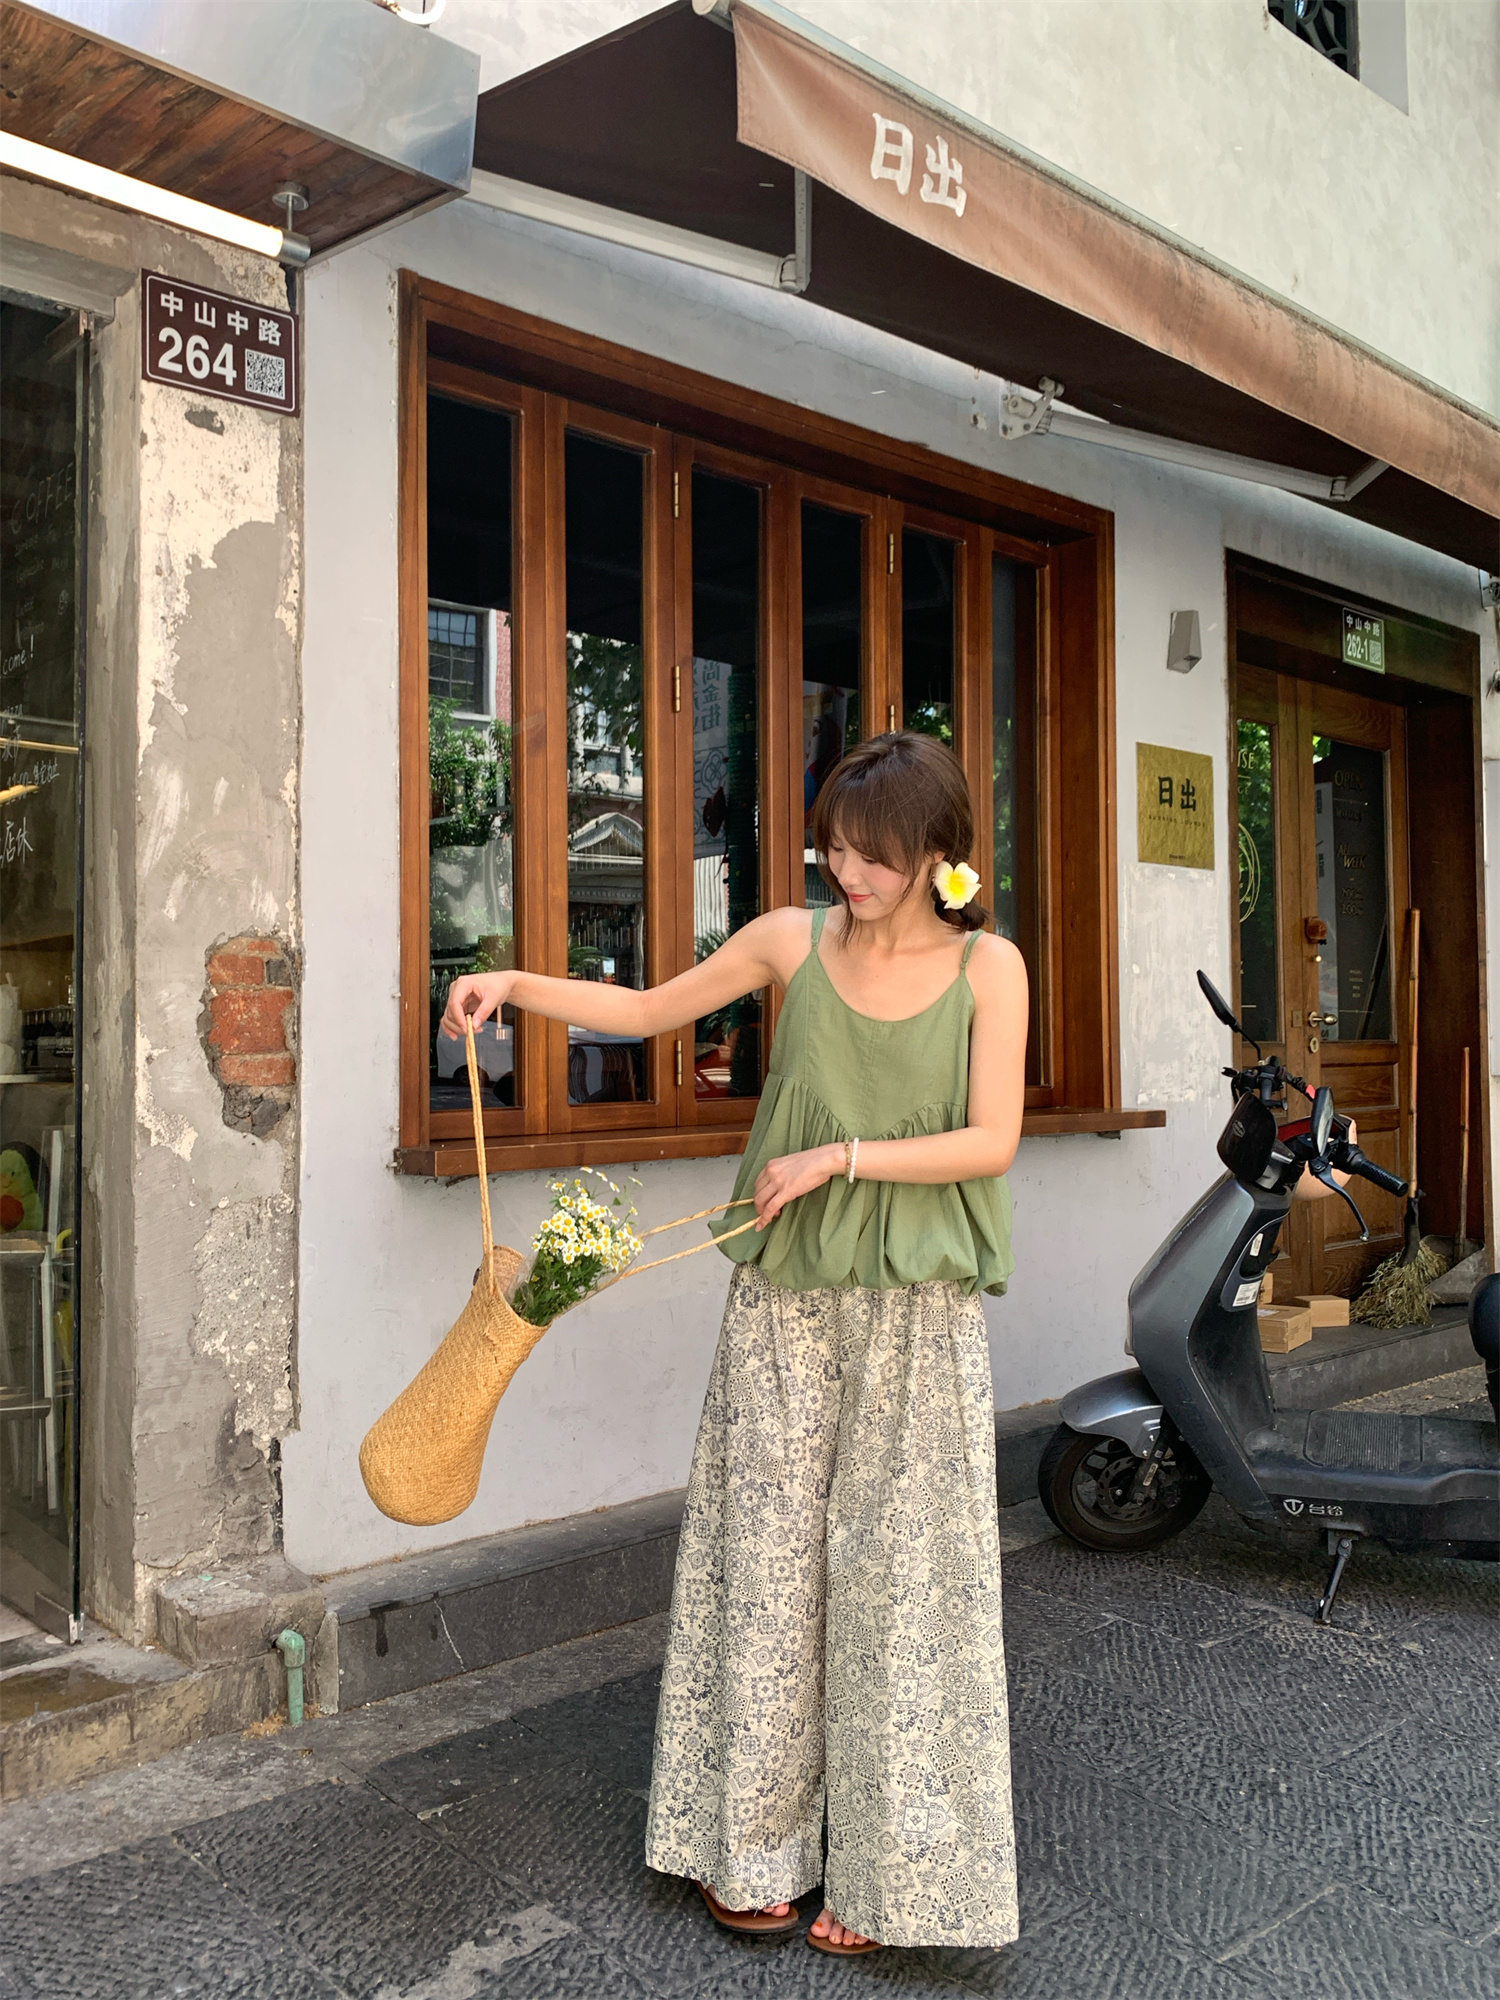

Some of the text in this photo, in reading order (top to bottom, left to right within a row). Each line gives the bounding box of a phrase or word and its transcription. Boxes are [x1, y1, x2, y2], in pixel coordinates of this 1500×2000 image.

[870, 112, 967, 218] 日出
[160, 291, 282, 346] 中山中路
[158, 326, 237, 387] 264
[1346, 614, 1380, 637] 中山中路
[0, 634, 34, 676] come!
[1158, 776, 1197, 812] 日出
[0, 817, 34, 868] 店休
